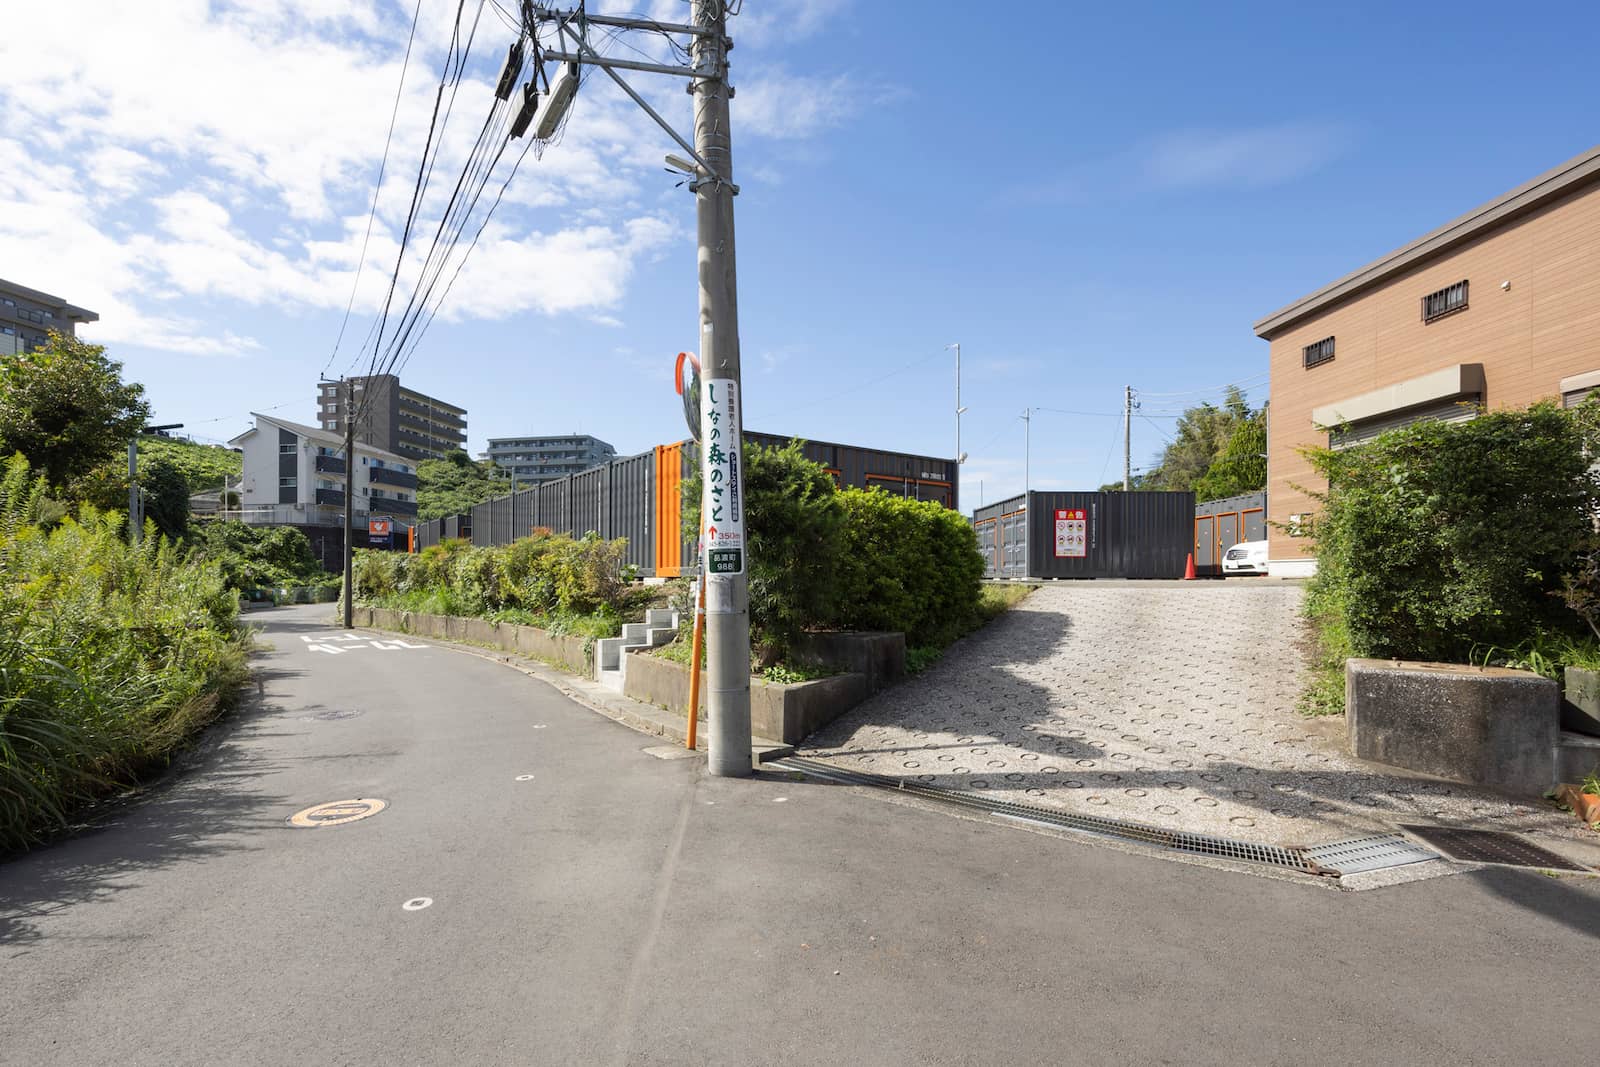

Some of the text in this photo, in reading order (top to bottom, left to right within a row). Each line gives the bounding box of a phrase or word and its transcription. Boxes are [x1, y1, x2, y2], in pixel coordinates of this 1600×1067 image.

[707, 383, 728, 522] しなの森のさと
